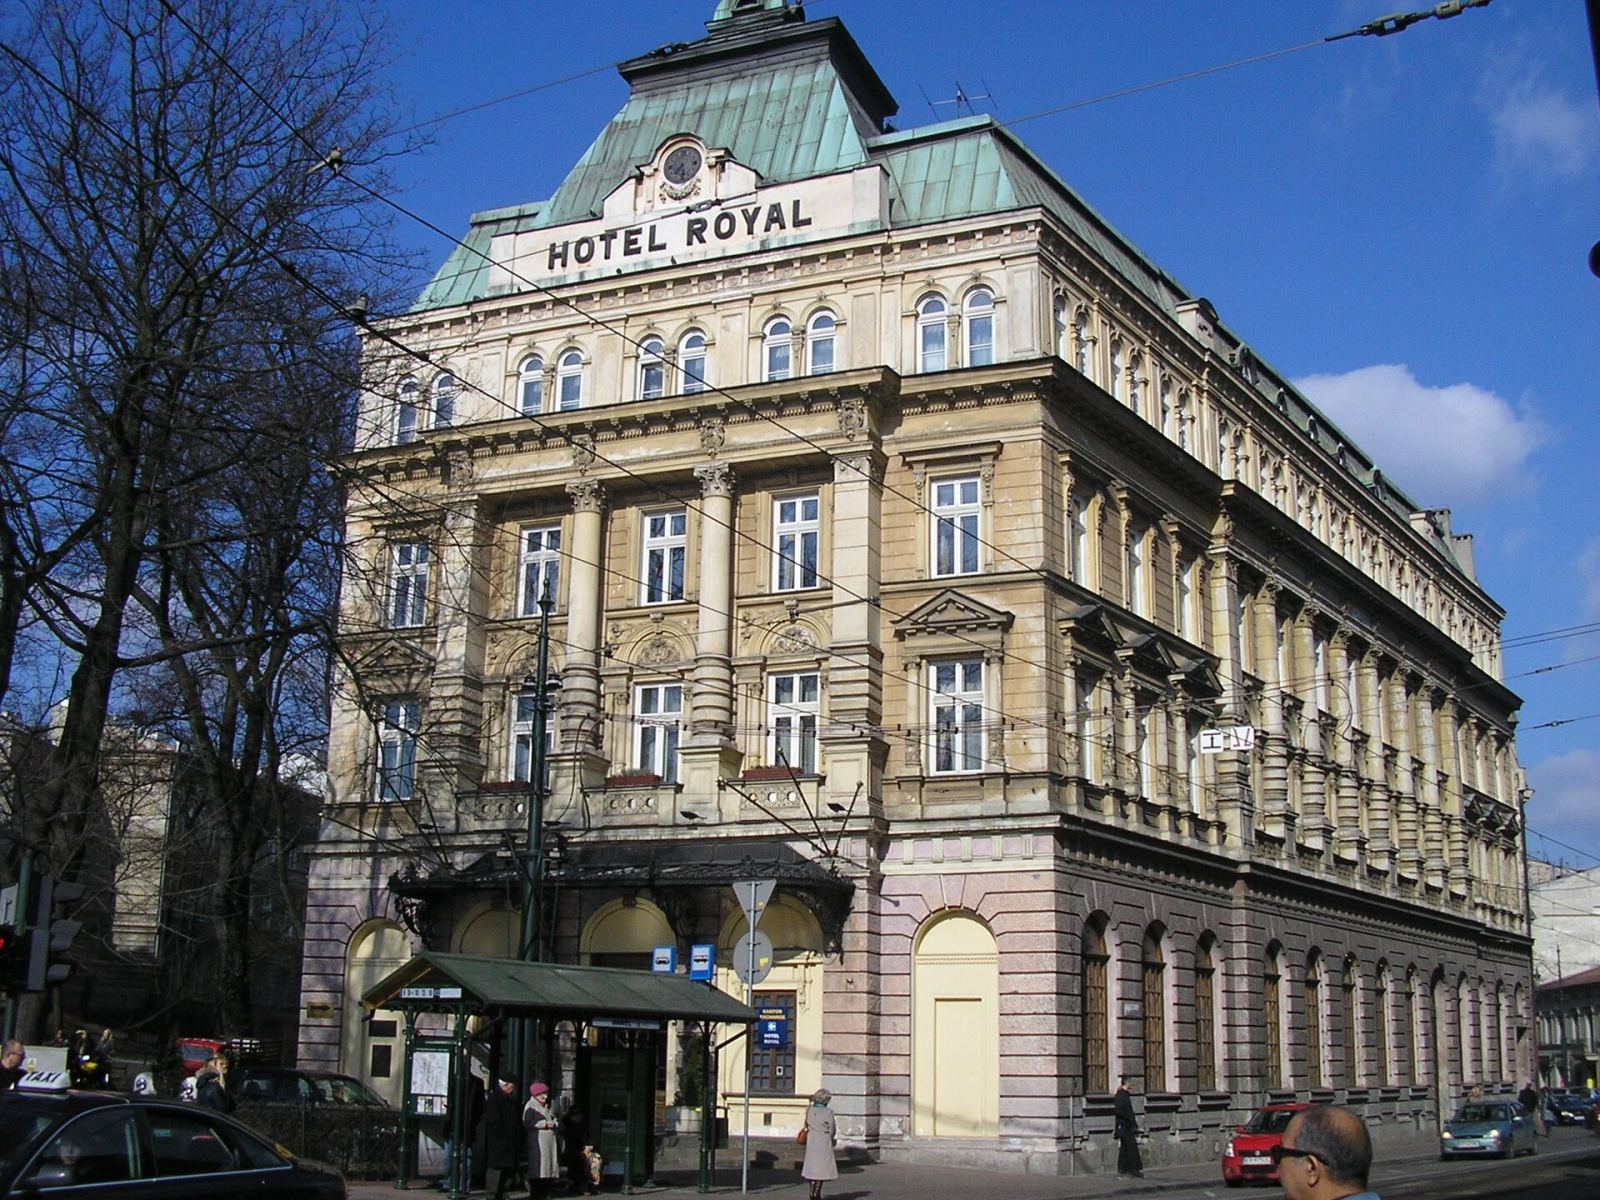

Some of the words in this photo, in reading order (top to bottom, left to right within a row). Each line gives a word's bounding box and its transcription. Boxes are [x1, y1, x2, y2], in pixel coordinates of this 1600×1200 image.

[548, 224, 667, 270] HOTEL
[686, 199, 812, 246] ROYAL
[25, 1071, 62, 1083] TAXI
